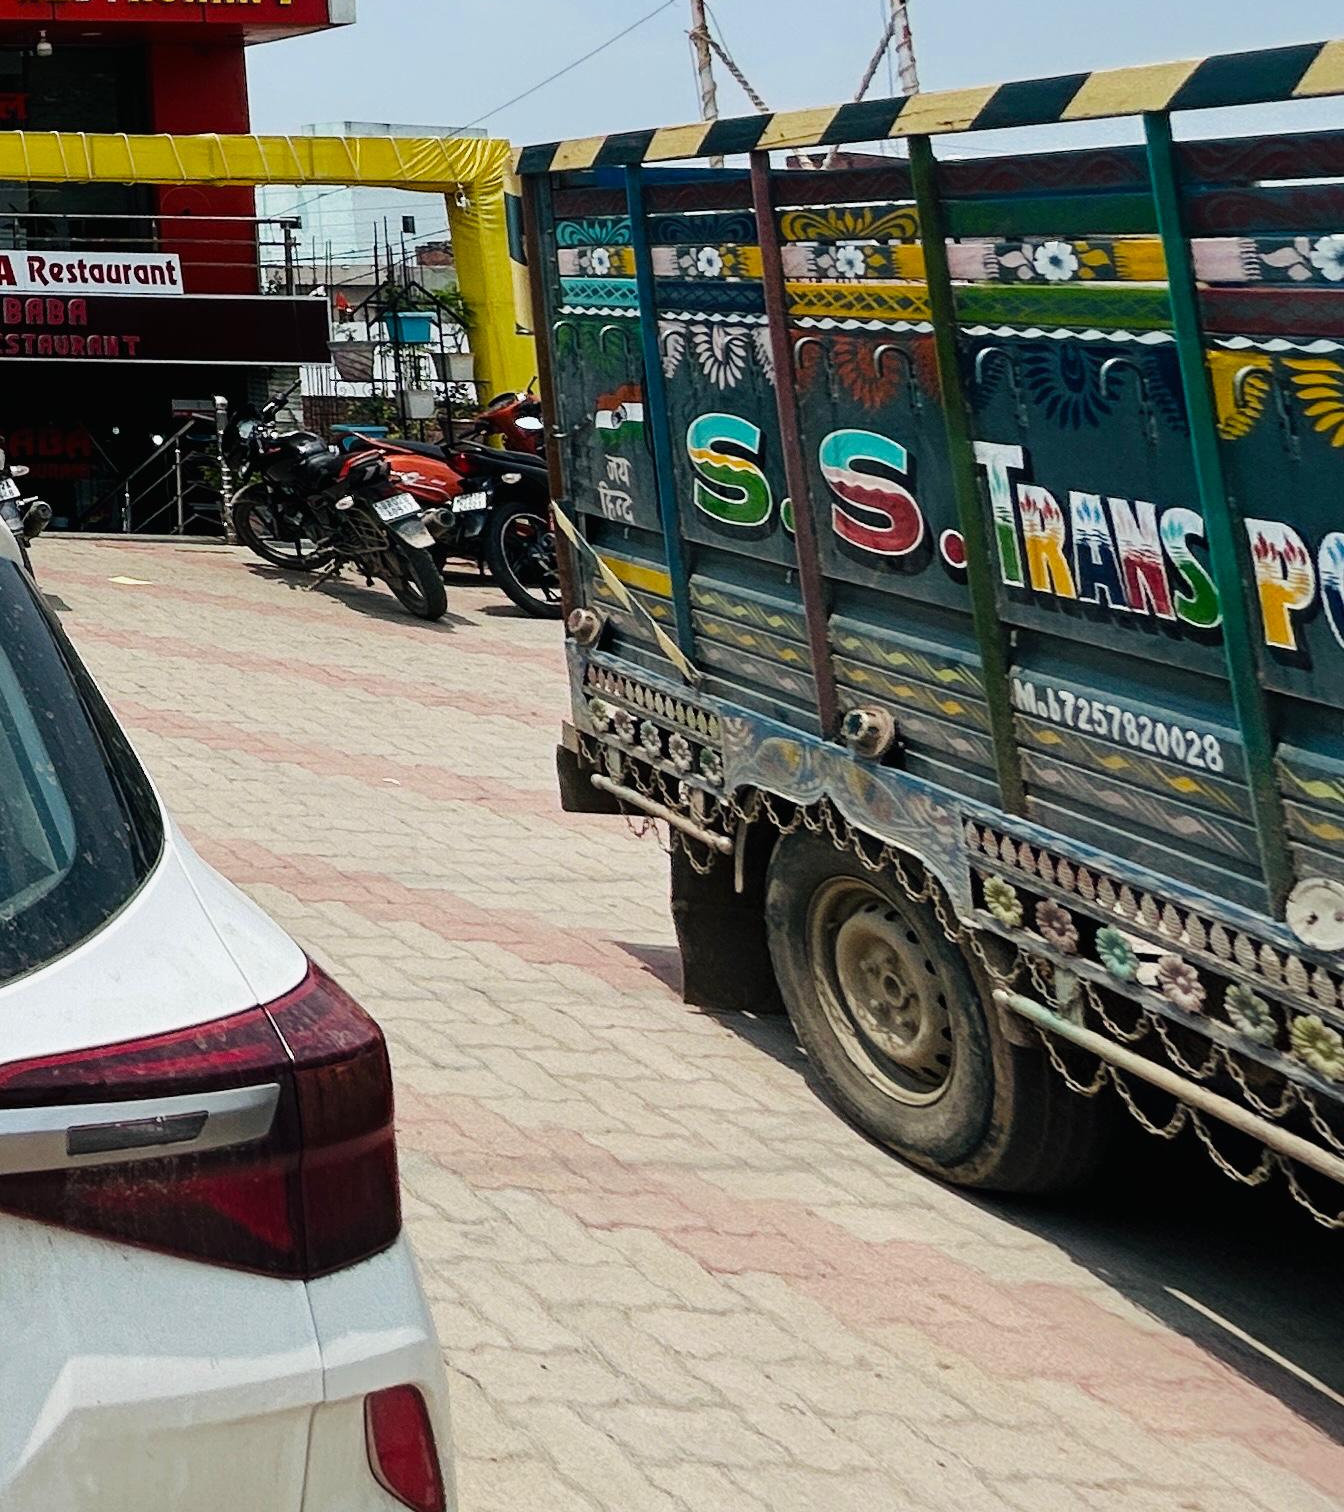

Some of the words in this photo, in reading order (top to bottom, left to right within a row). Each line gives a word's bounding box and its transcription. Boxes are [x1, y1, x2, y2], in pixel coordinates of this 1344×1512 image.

[27, 255, 178, 287] Restaurant
[2, 297, 88, 326] BABA
[604, 453, 632, 488] जय
